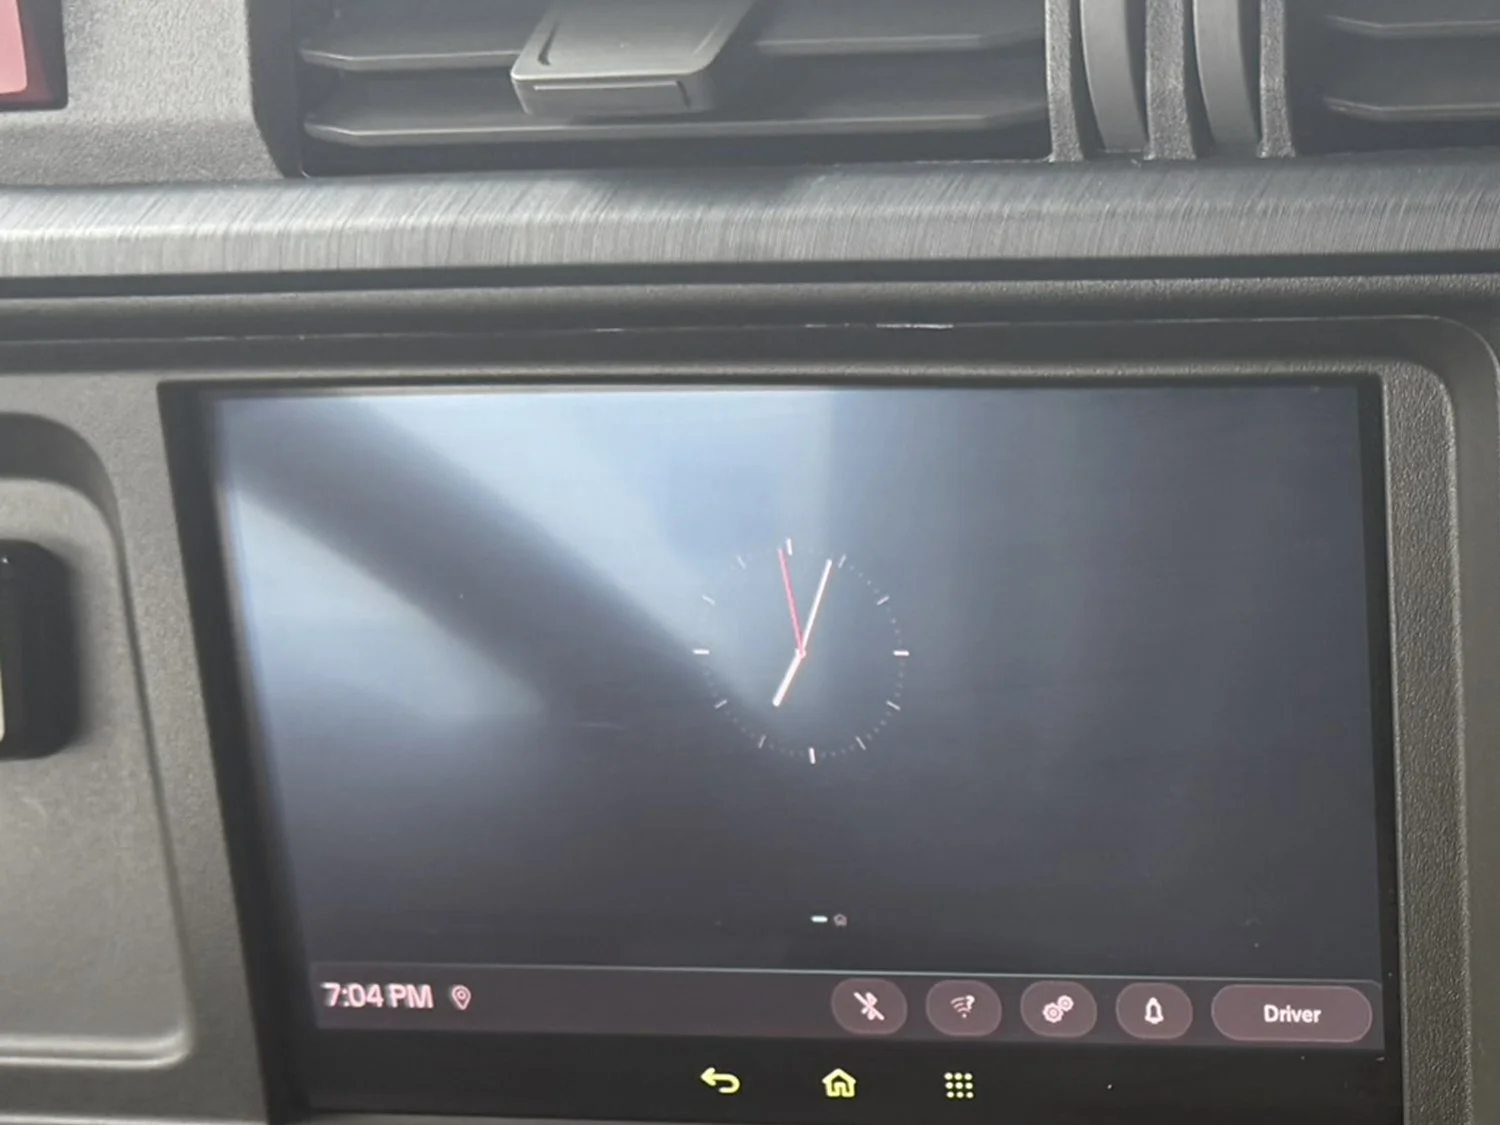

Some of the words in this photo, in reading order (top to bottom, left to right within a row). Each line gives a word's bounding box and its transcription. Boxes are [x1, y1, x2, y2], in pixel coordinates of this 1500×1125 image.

[321, 982, 384, 1008] 7:04
[387, 984, 433, 1008] PM
[1264, 1003, 1322, 1023] Driver
